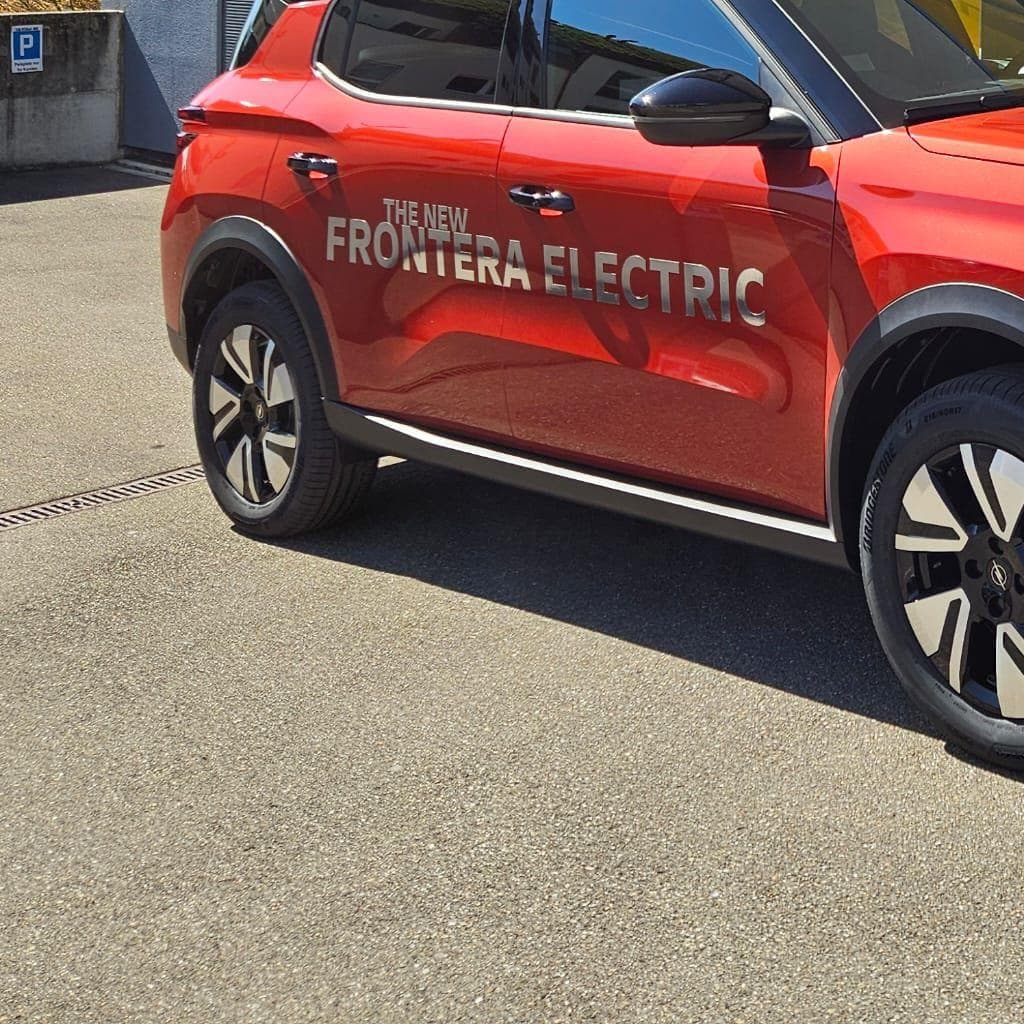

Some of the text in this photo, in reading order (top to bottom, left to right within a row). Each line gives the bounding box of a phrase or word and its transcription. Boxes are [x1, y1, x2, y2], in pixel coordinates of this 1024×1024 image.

[20, 34, 34, 57] P
[383, 198, 469, 233] THE NEW
[326, 215, 768, 327] FRONTERA ELECTRIC
